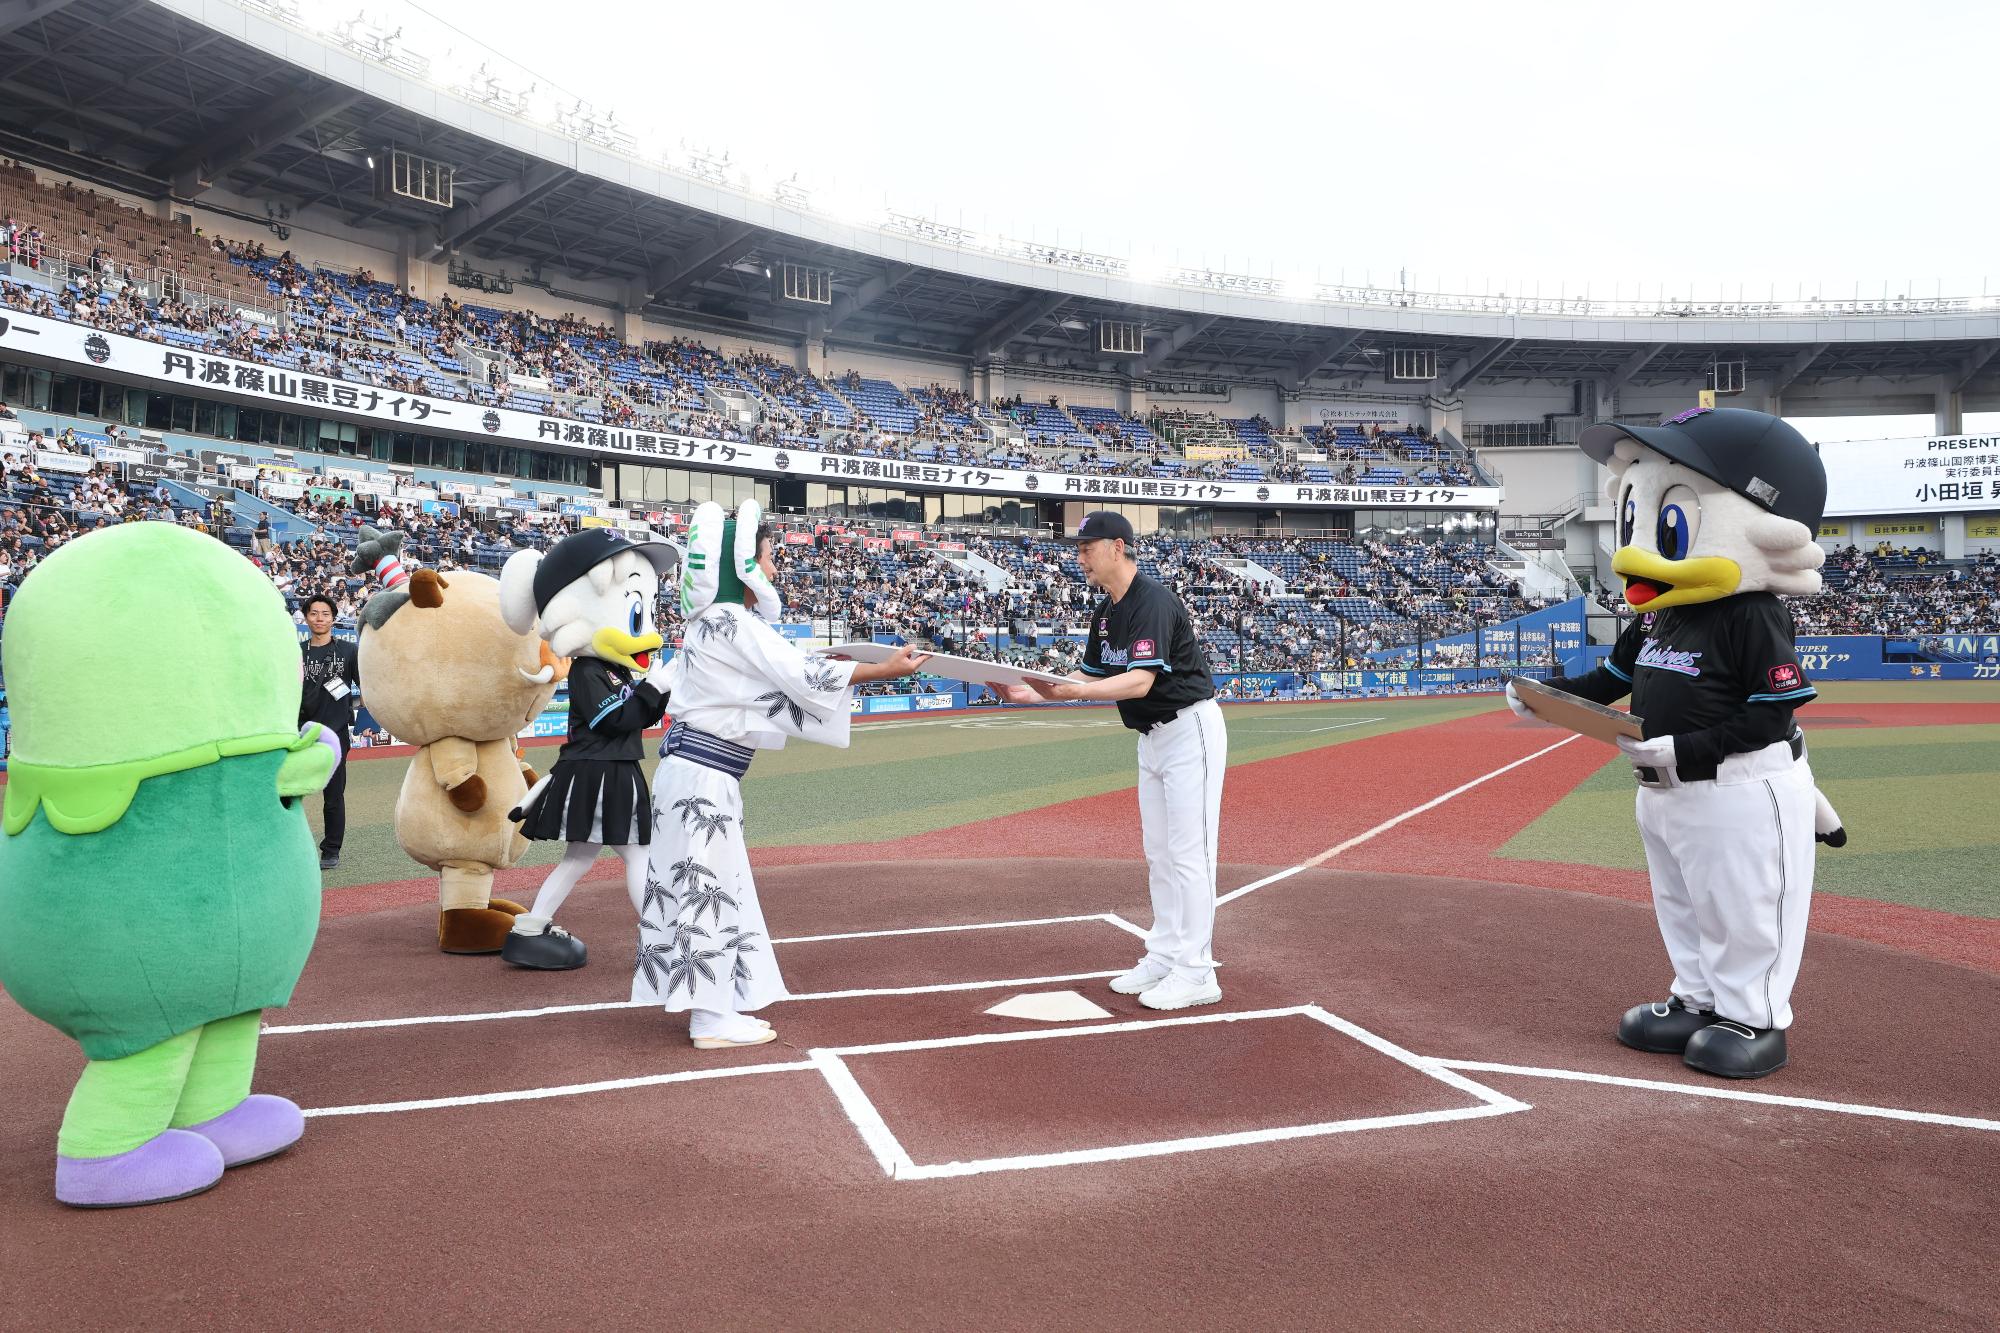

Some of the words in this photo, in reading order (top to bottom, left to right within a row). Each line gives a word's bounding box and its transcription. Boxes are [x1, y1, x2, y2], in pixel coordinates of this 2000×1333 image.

[162, 351, 452, 420] 丹波篠山黒豆ナイター
[538, 420, 752, 462] 丹波篠山黒豆ナイター
[1928, 437, 2000, 450] PRESENT
[821, 456, 1005, 486] 丹波篠山黒豆ナイター
[1065, 477, 1236, 499] 丹波篠山黒豆ナイター
[1297, 487, 1469, 503] 丹波篠山黒豆ナイター
[1915, 481, 1984, 502] 小田垣
[1874, 525, 1925, 534] 日比野不動産
[1794, 645, 1828, 653] SUPER
[1389, 671, 1408, 685] 市進
[598, 693, 619, 709] LOTTE
